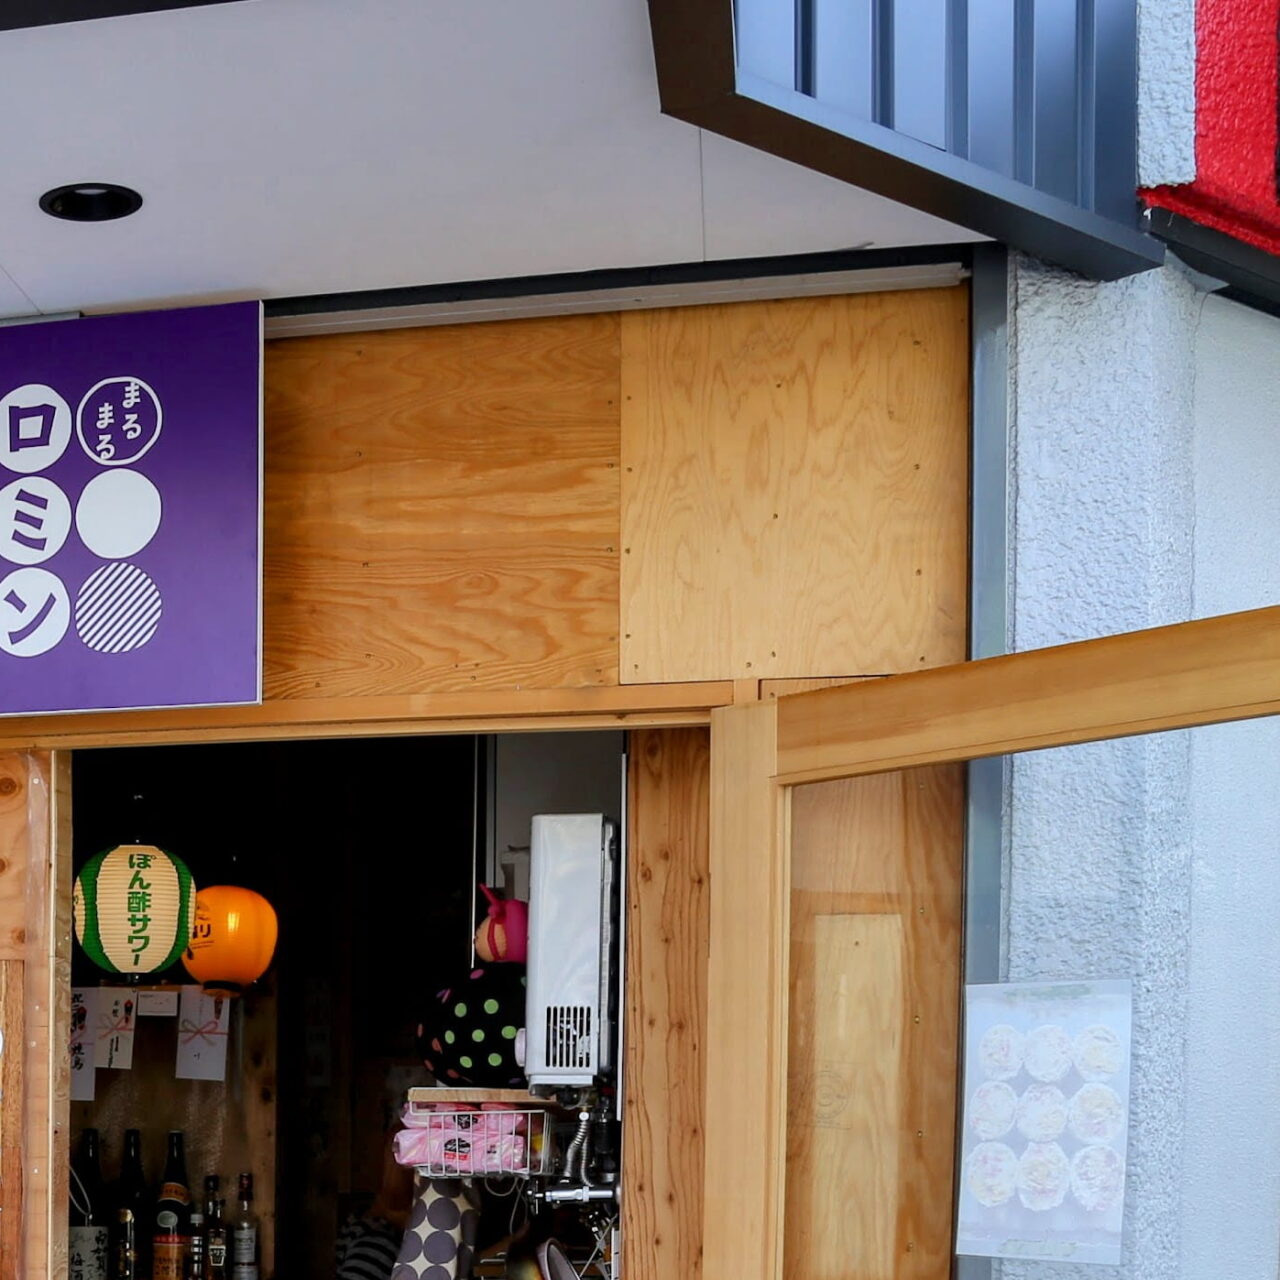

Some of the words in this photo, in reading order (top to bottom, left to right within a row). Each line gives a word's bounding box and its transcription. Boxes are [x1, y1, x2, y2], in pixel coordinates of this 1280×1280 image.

[127, 852, 157, 967] ぽん酢サワー
